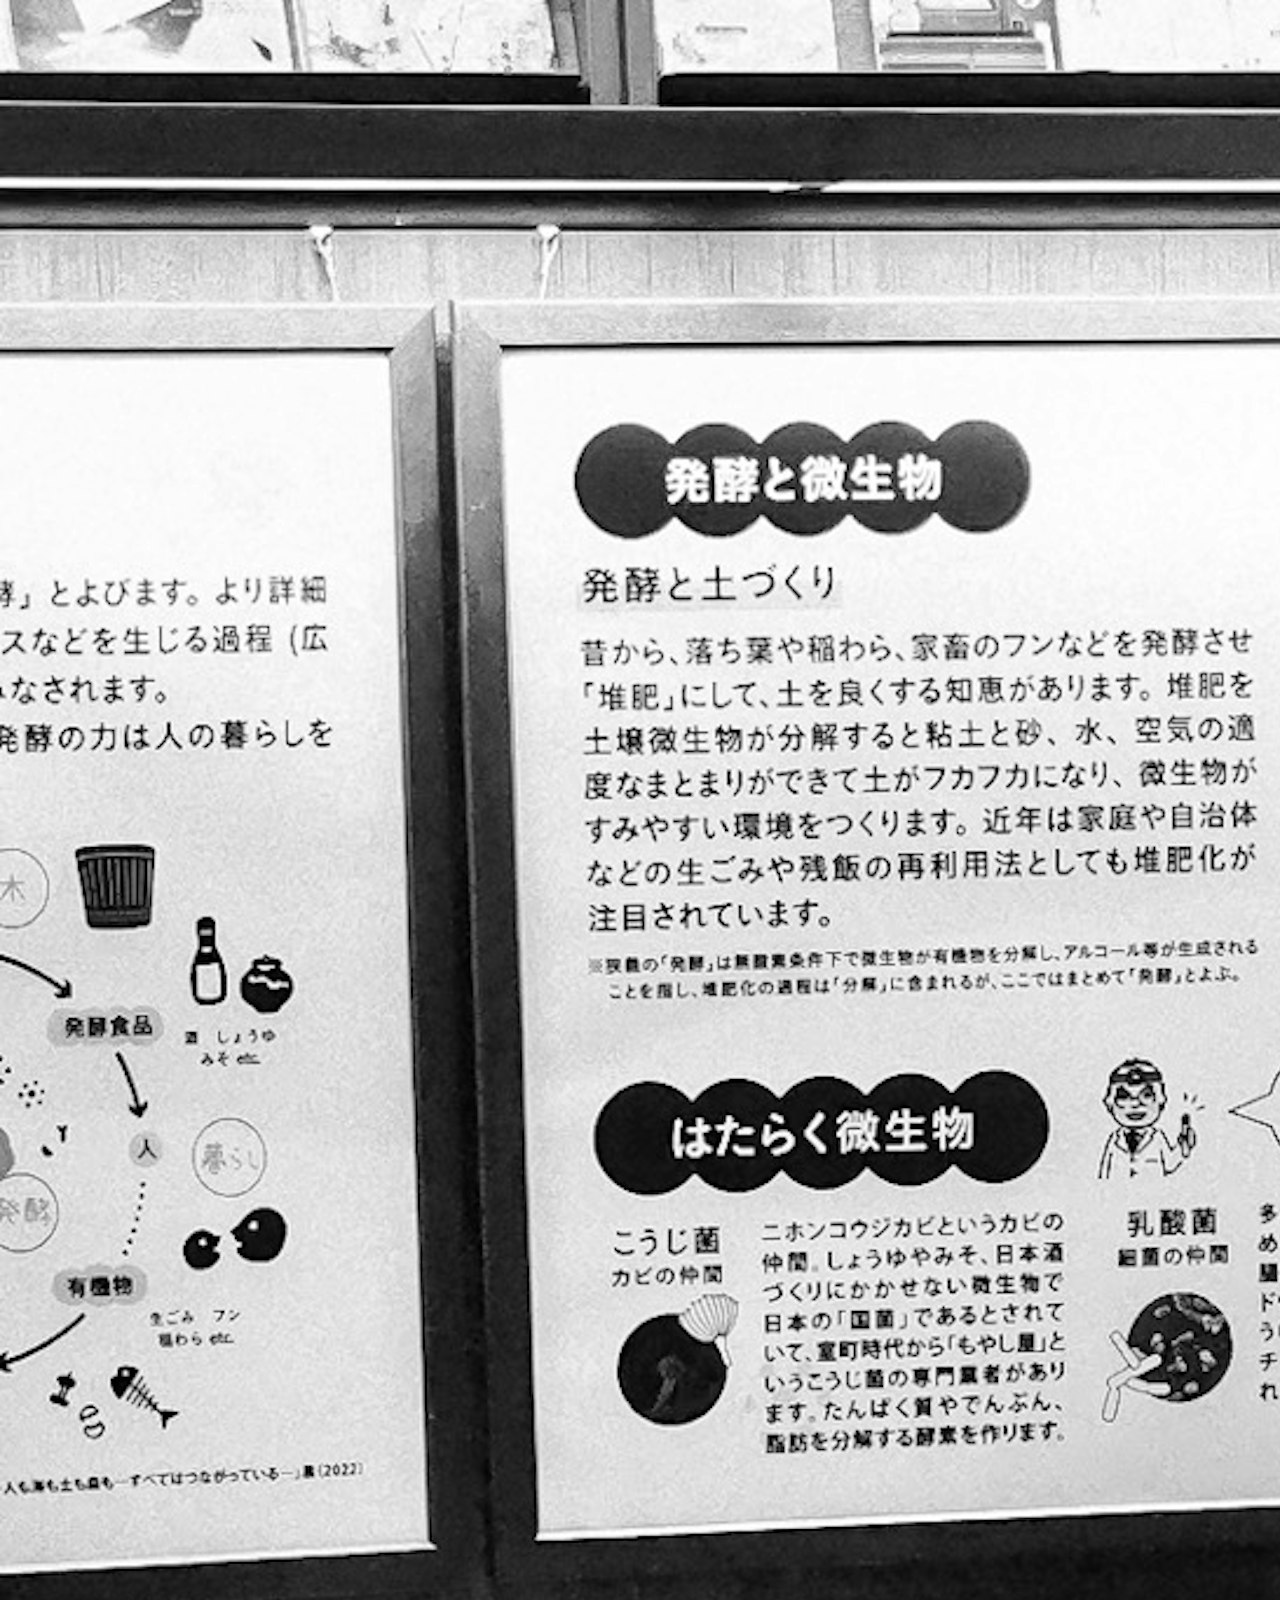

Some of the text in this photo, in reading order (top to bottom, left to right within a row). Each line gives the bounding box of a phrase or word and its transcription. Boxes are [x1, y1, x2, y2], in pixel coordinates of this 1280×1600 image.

[665, 454, 944, 504] 発酵と微生物
[583, 566, 837, 604] 発酵と土づくり
[580, 628, 1254, 668] 昔から、落ち葉や稲わら、家畜のフンなどを発酵させ
[580, 671, 1255, 712] 「堆肥」にして、土を良くする知恵があります。堆肥を
[0, 719, 333, 754] 発酵の力は人の暮らしを
[584, 714, 1257, 756] 土壌微生物が分解すると粘土と砂、水、空気の適
[585, 757, 1258, 801] 度なまとまりができて土がフカフカになり、微生物が
[586, 800, 1259, 844] すみやすい環境をつくります。近年は家庭や自治体
[587, 843, 1258, 887] などの生ごみや残飯の再利用法としても堆肥化が
[588, 899, 836, 933] 注目されています。
[65, 1015, 153, 1039] 発酵食品
[218, 1029, 276, 1044] しょうゆ
[672, 1107, 974, 1159] はたらく微生物
[137, 1140, 158, 1160] 人
[202, 1142, 259, 1175] 暮らし
[762, 1213, 1064, 1241] ニホンコウジカビというカビの
[1127, 1208, 1219, 1239] 乳酸菌
[612, 1226, 721, 1257] こうじ菌
[1118, 1243, 1231, 1269] 細菌の仲間
[762, 1242, 1064, 1273] 仲間。しょうゆやみそ、日本酒
[68, 1275, 133, 1298] 有機物
[610, 1263, 724, 1289] カビの仲間
[762, 1272, 1064, 1302] づくりにかかせない微生物で
[214, 1309, 240, 1323] フン
[764, 1302, 1065, 1333] 日本の「国菌」であるとされて
[764, 1331, 1066, 1362] いて、室町時代から「もやし屋」と
[765, 1421, 1066, 1453] 脂肪を分解する酵素を作ります。
